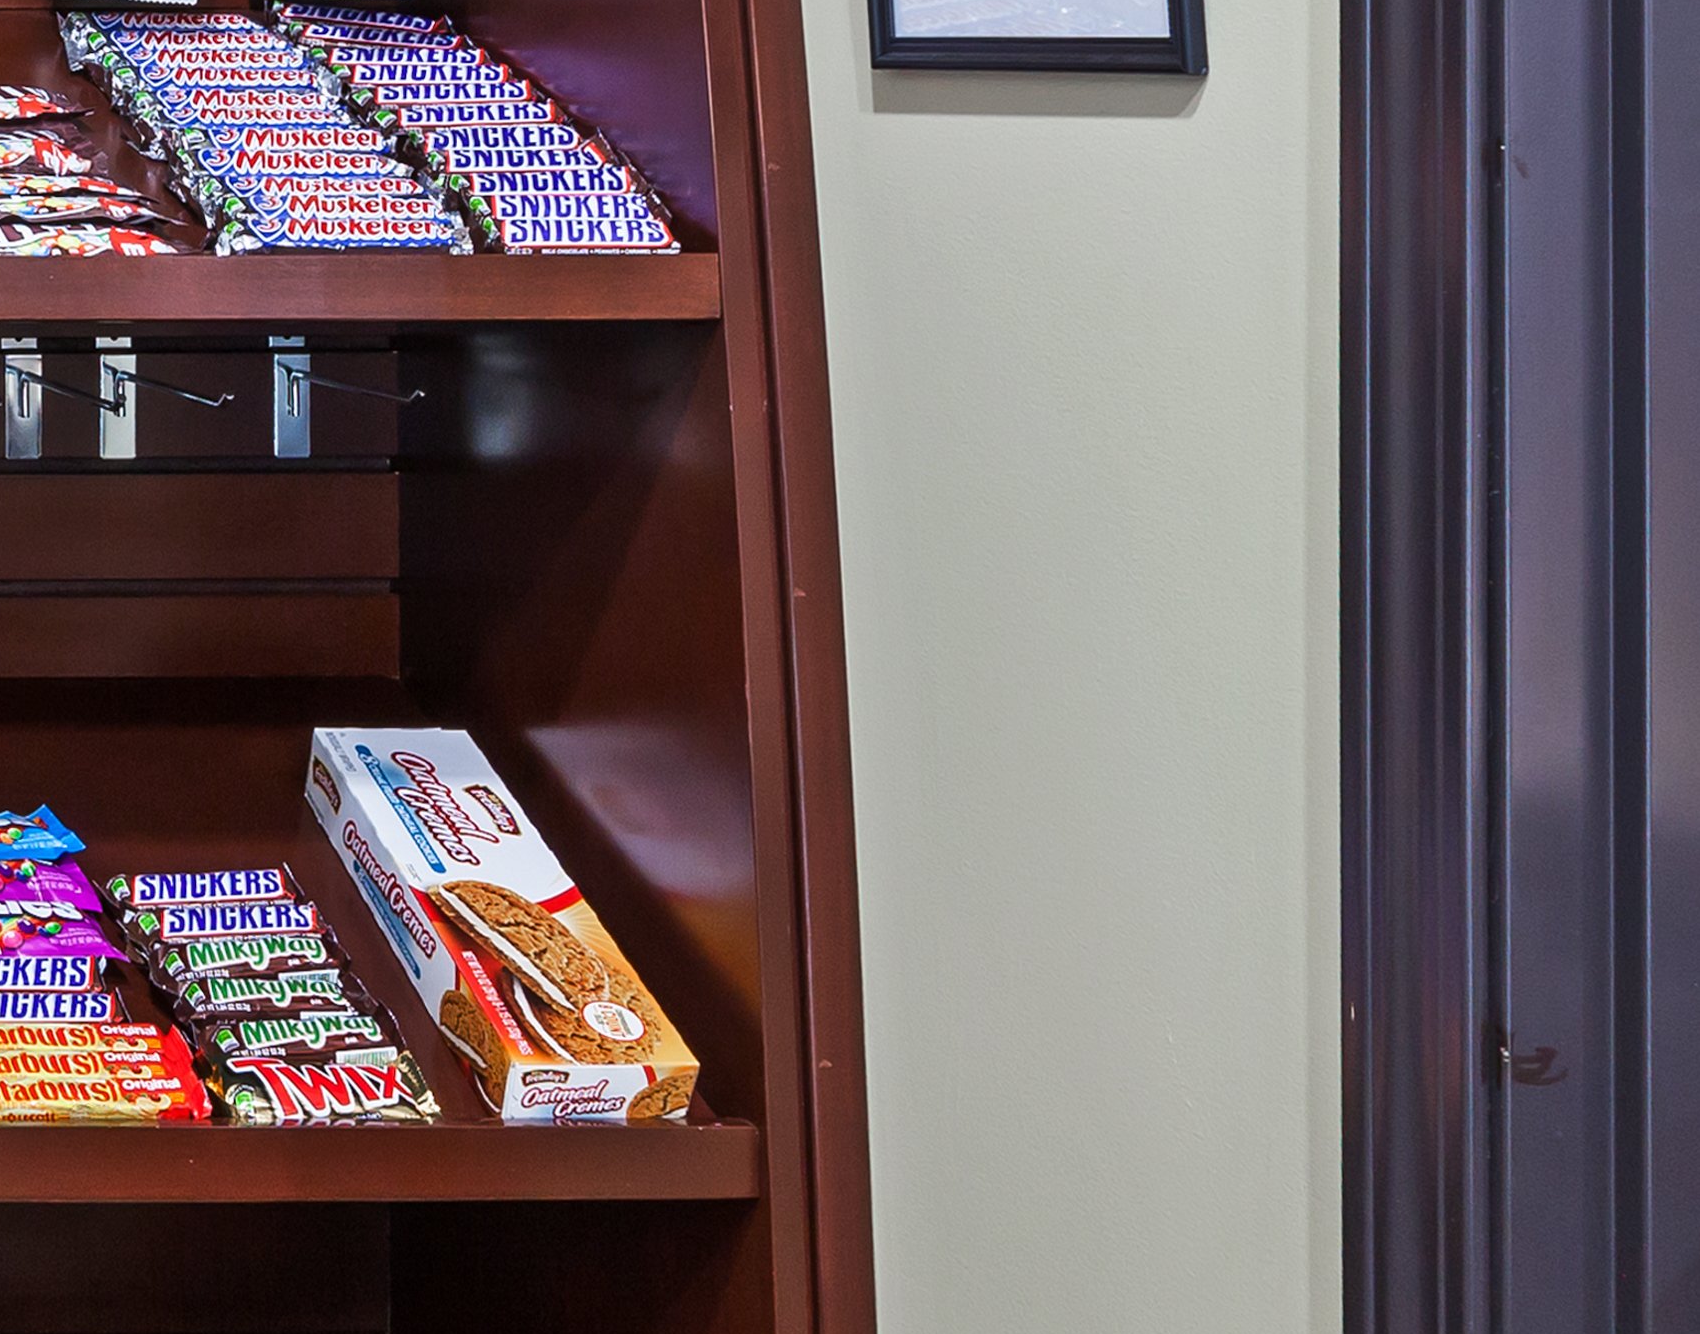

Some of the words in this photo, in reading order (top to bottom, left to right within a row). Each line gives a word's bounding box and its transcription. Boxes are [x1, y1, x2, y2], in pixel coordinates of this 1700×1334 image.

[510, 220, 667, 244] SNICKERS
[121, 1077, 181, 1092] Original
[231, 1057, 414, 1118] TWIX
[521, 1080, 605, 1109] Oatmeal
[554, 1095, 625, 1118] Cremes
